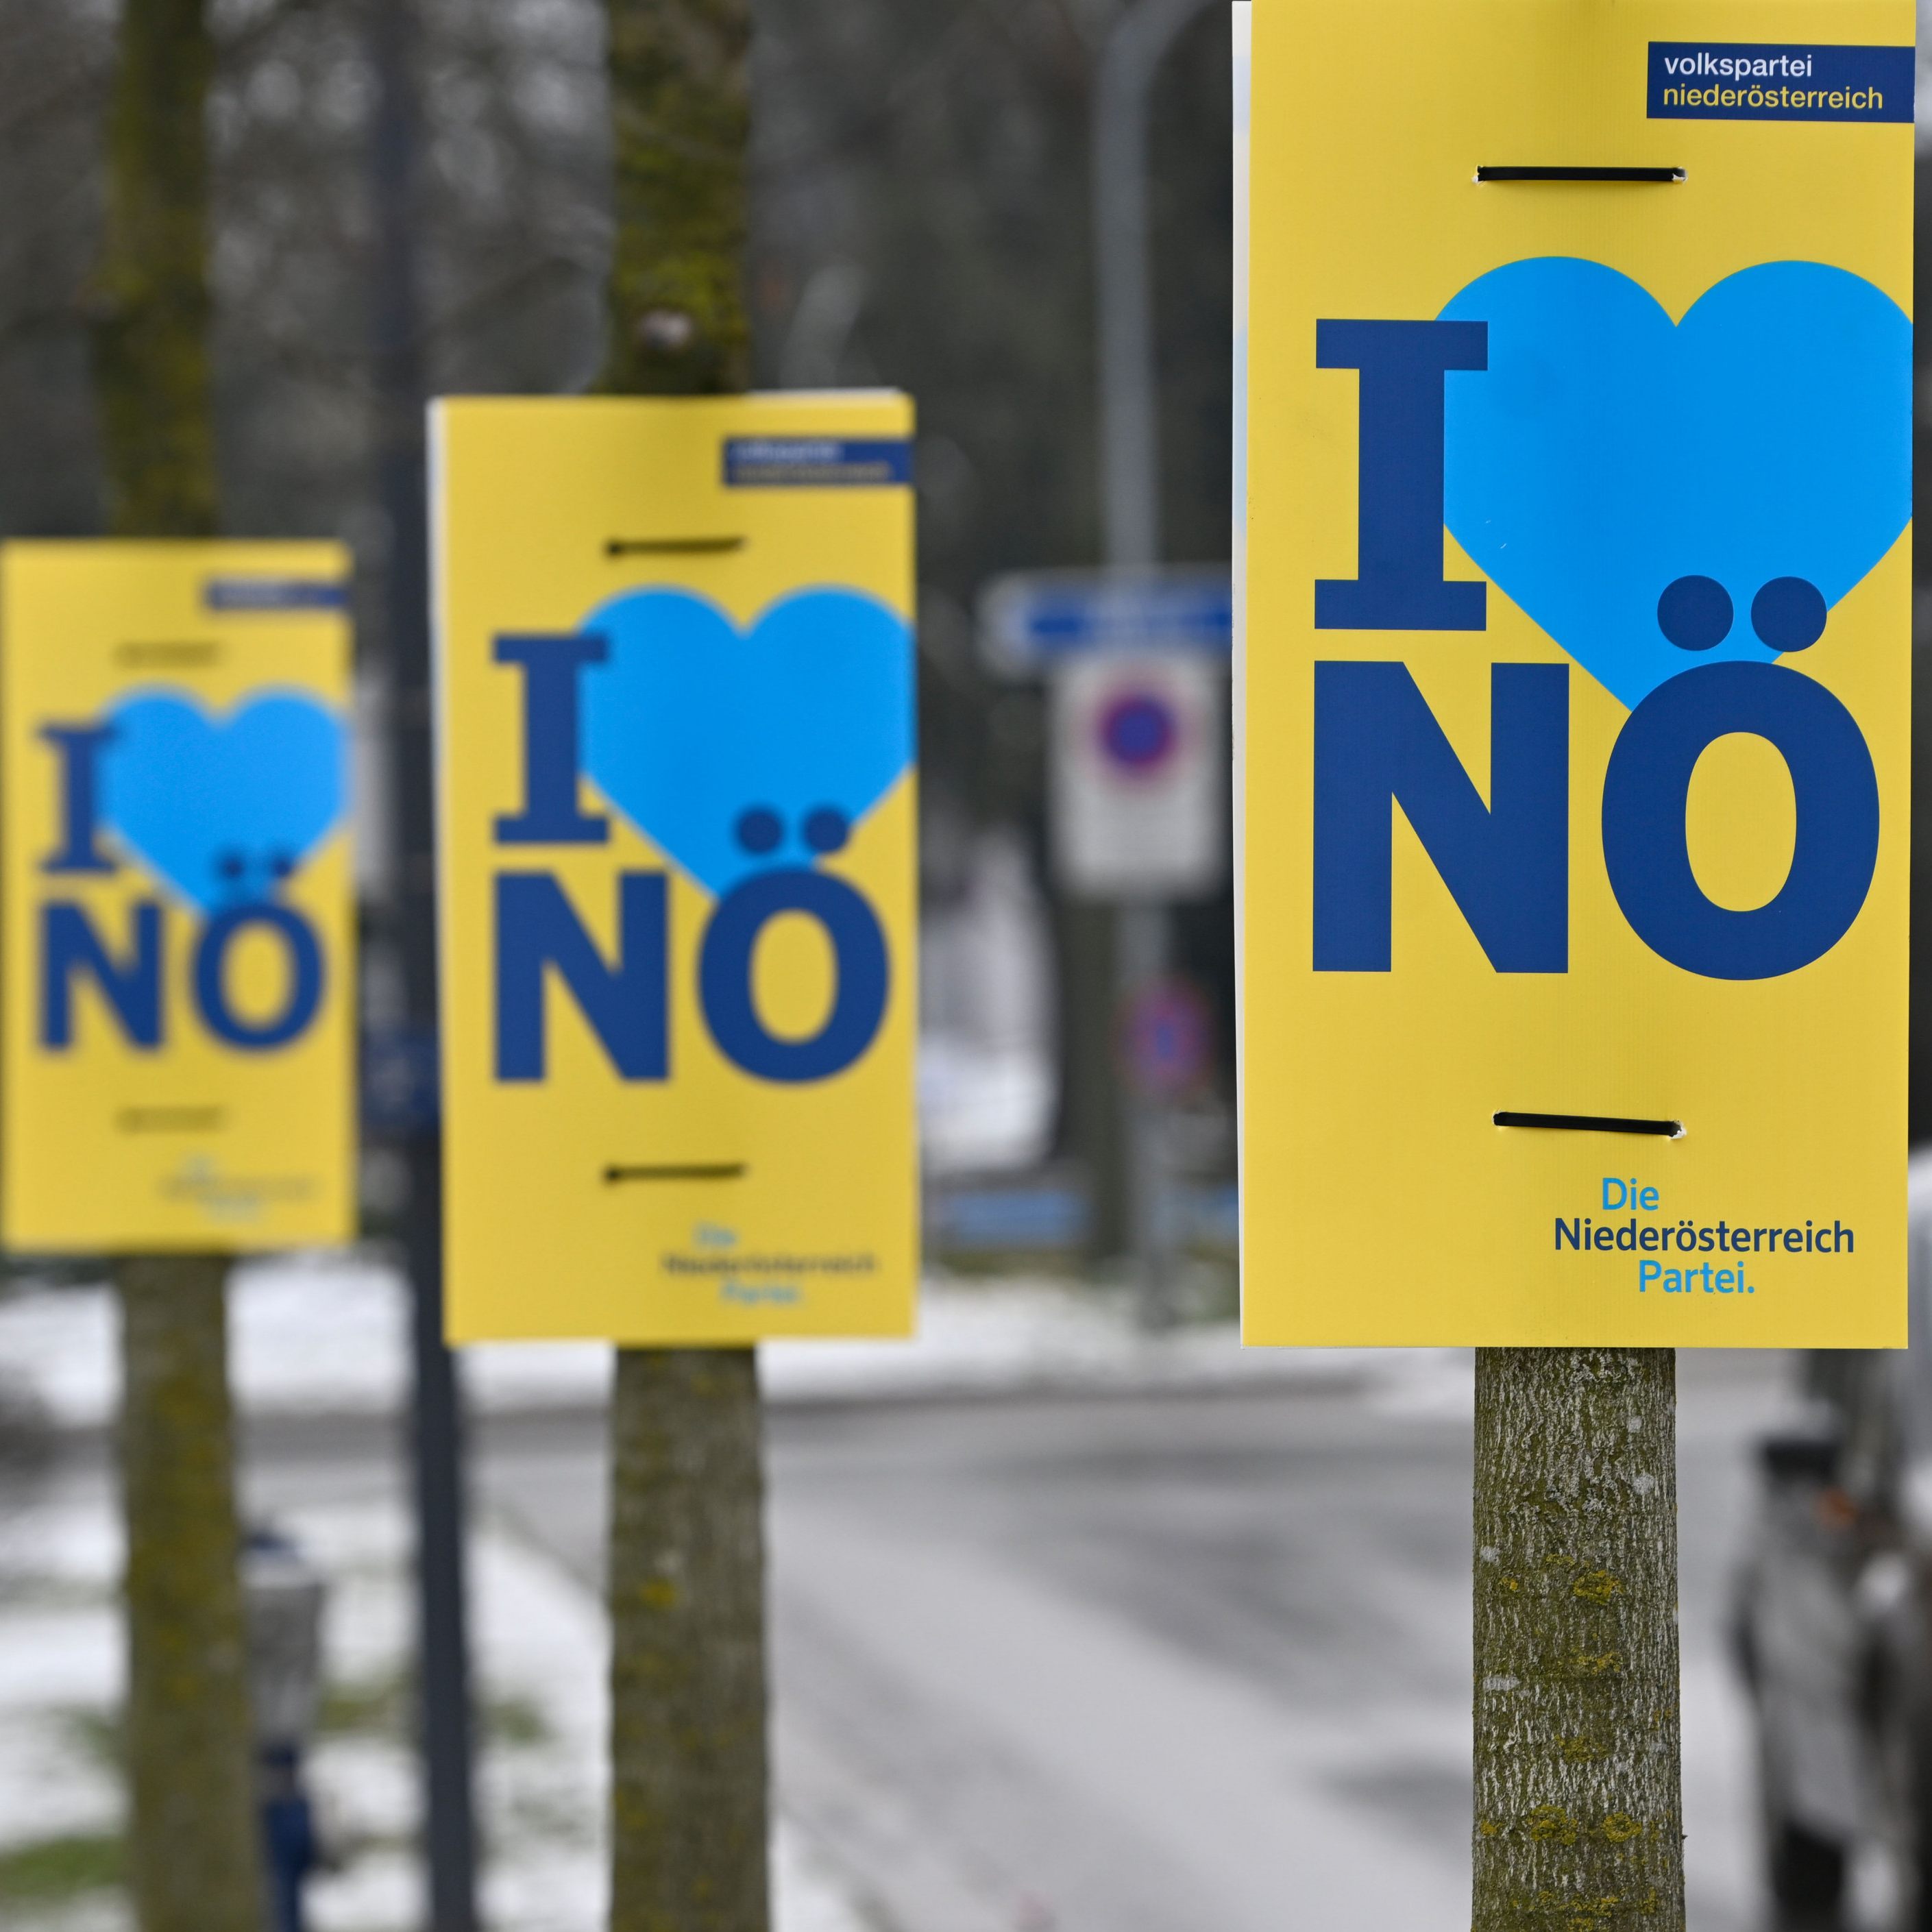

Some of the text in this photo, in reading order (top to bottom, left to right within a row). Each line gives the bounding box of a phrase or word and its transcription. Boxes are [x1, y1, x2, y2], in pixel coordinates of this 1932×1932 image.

[1663, 83, 1883, 109] niederösterreich
[1665, 52, 1812, 81] volkspartei
[1315, 319, 1489, 631] I
[37, 718, 122, 877] I
[492, 630, 613, 846] I
[1312, 574, 1880, 981] NÖ
[36, 848, 329, 1055] NÖ
[493, 803, 892, 1086] NÖ
[1555, 1217, 1854, 1253] Niederösterreich
[1602, 1177, 1660, 1211] Die
[1639, 1260, 1755, 1294] Partei.
